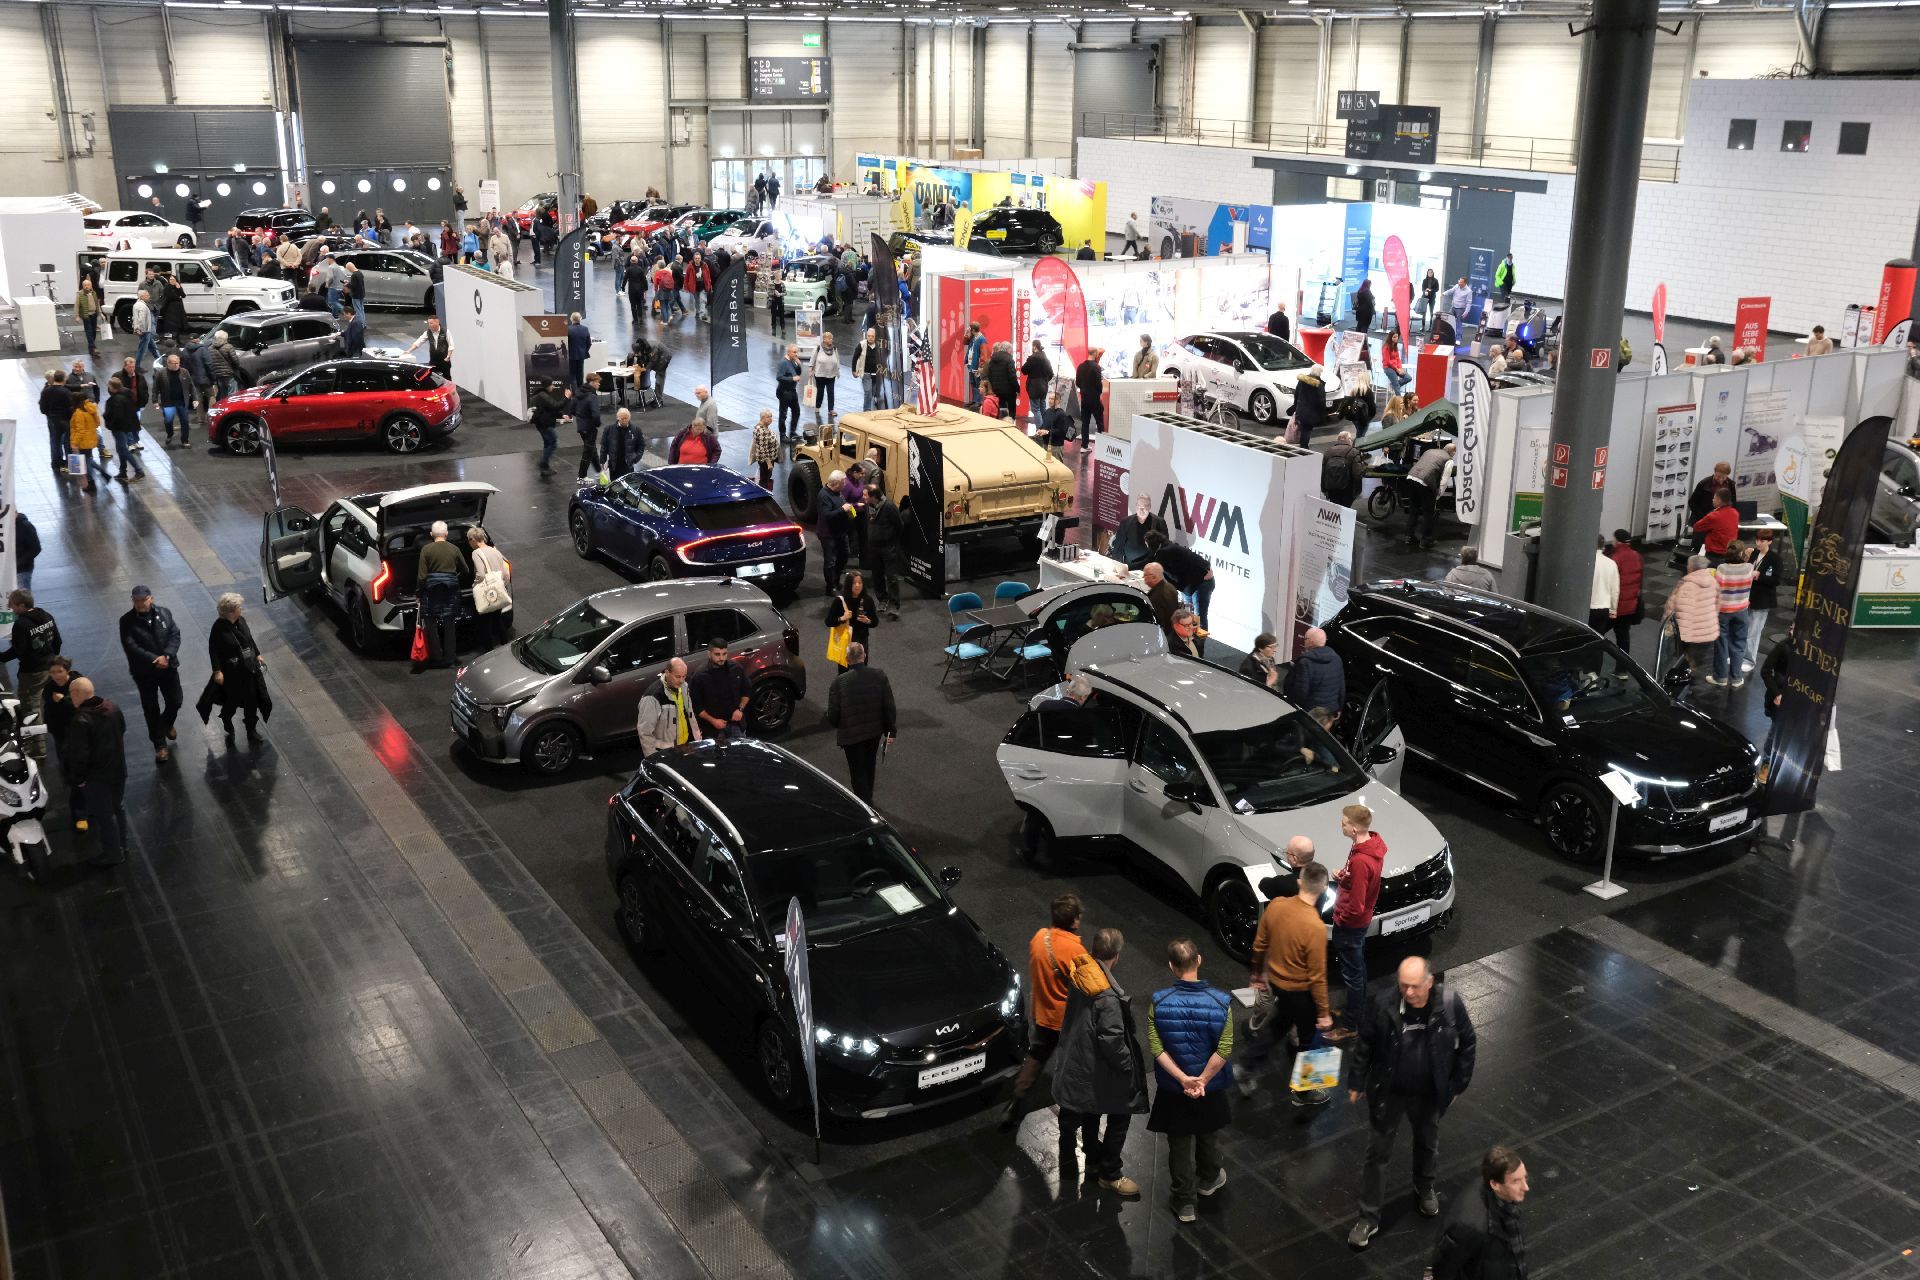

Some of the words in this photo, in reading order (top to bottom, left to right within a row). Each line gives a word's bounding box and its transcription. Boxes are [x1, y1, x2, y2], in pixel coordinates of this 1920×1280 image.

[730, 278, 740, 347] MERBAG
[1158, 483, 1249, 555] AWM
[1317, 508, 1342, 526] AWM
[1215, 559, 1250, 580] MITTE
[1394, 914, 1420, 927] Sportage
[935, 1022, 960, 1036] KIA
[964, 1058, 983, 1069] SW
